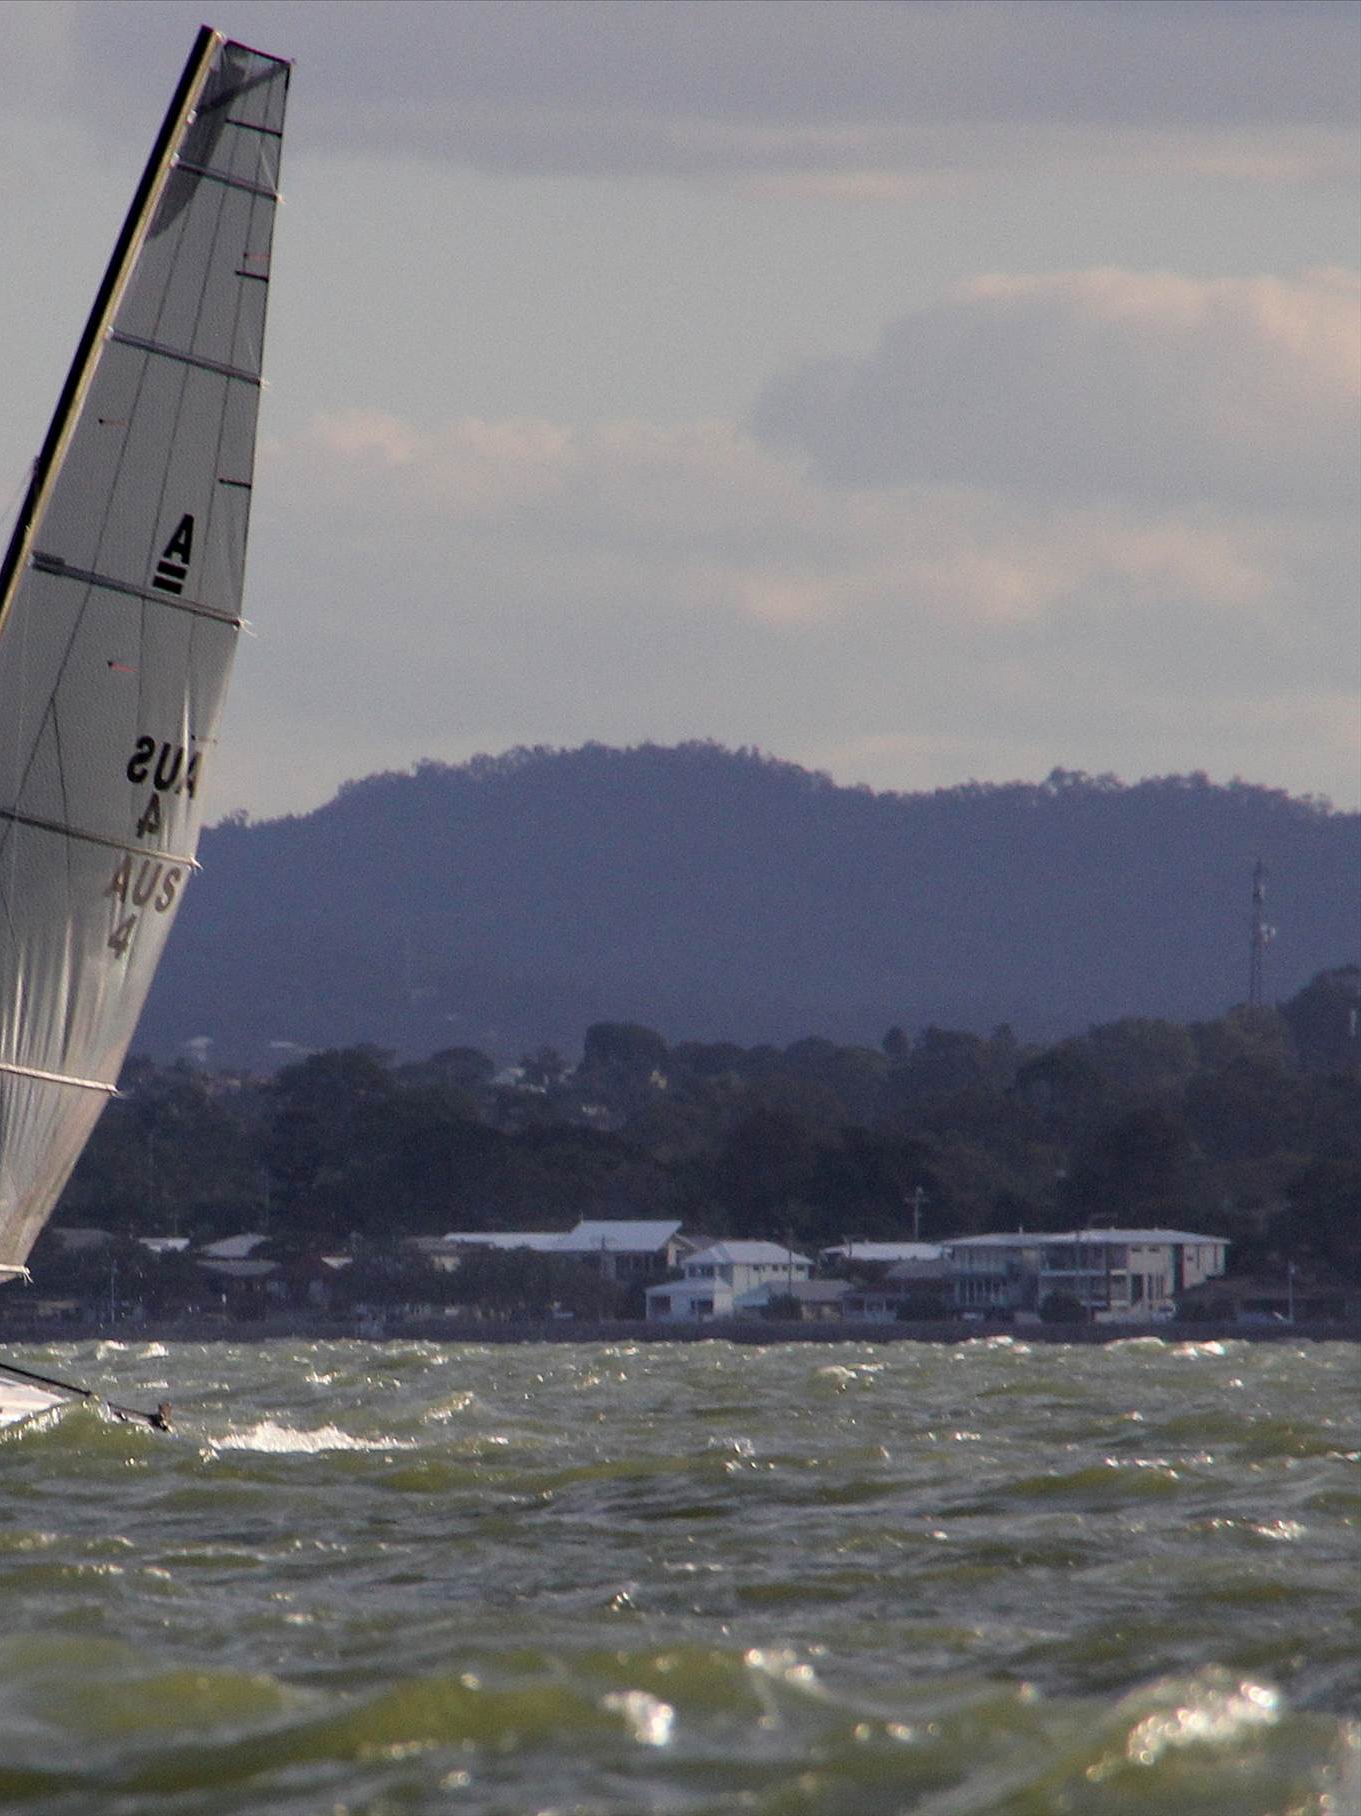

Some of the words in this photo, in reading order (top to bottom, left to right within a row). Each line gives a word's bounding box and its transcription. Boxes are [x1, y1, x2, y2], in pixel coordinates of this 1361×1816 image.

[163, 513, 194, 565] A
[104, 853, 181, 913] AUS
[107, 913, 137, 959] 4
